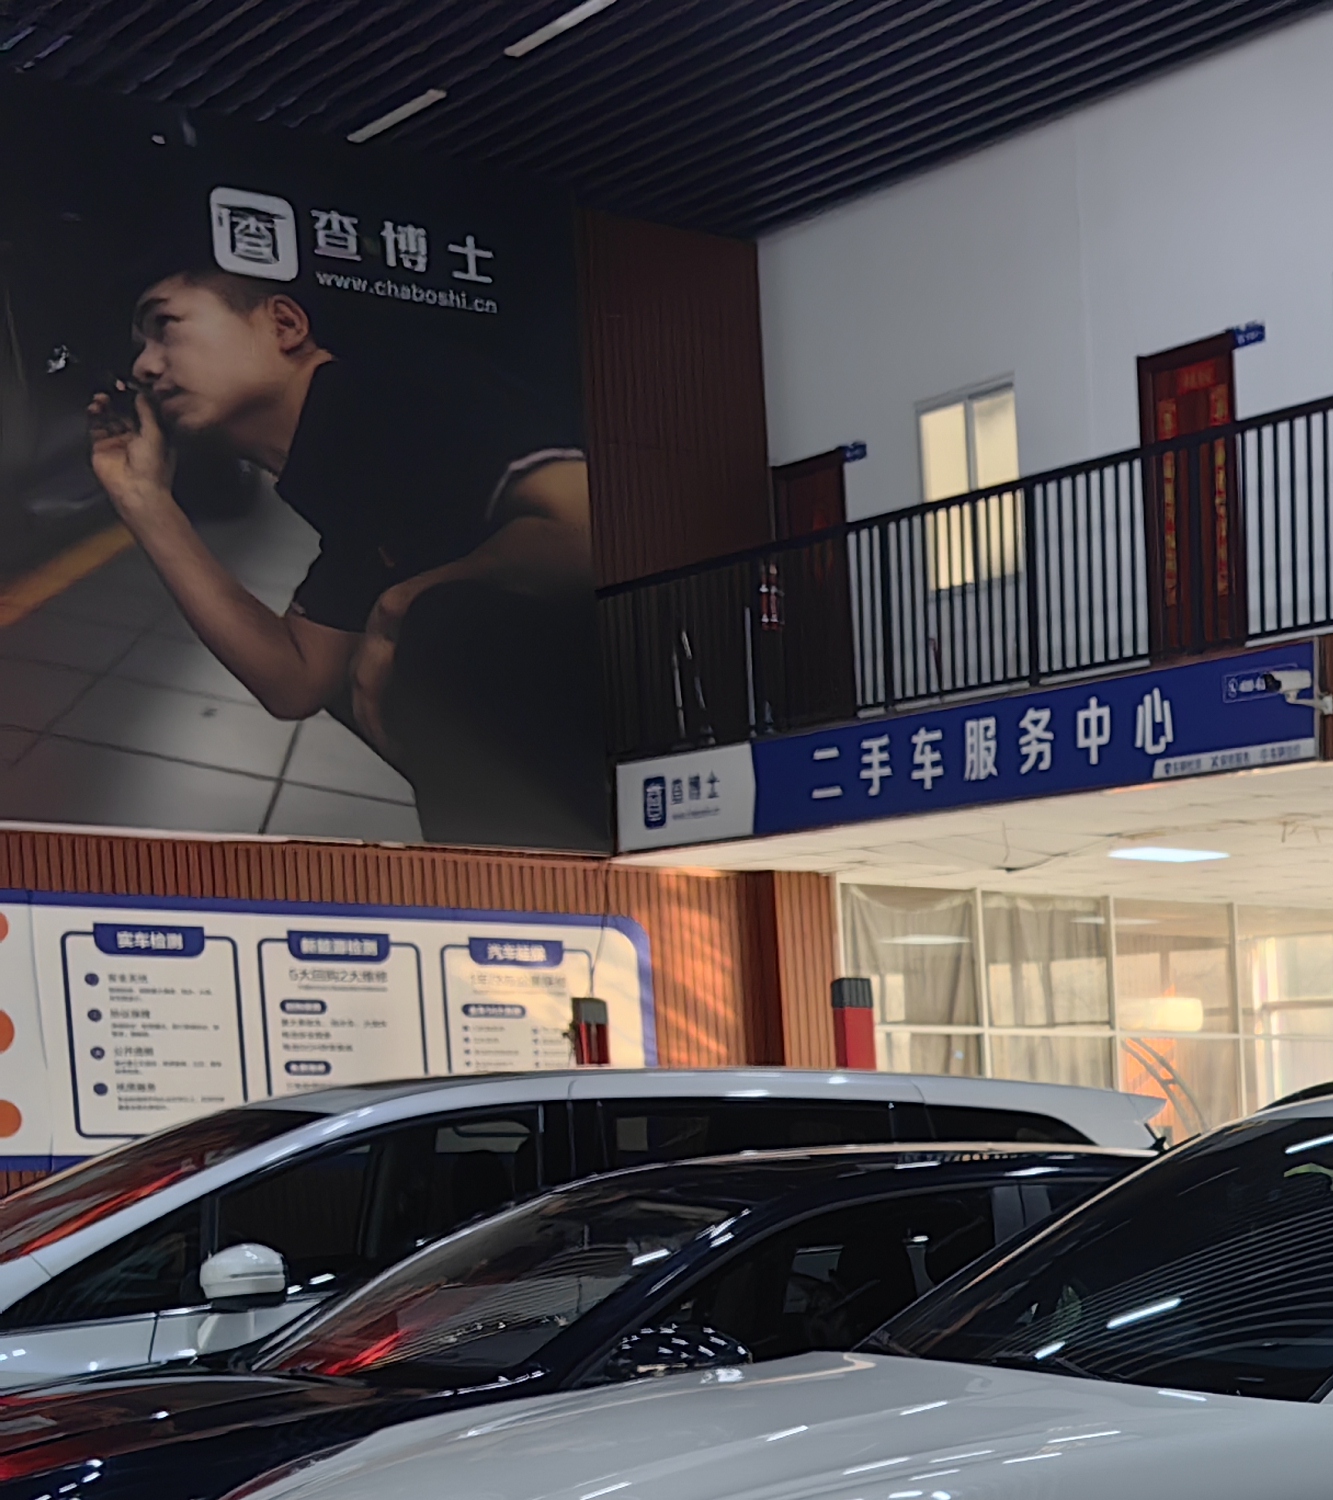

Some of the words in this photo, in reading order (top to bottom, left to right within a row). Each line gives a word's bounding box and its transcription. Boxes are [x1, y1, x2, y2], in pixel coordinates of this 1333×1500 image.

[310, 209, 494, 284] 查博士
[315, 270, 499, 315] www.chaboshi.cn
[811, 687, 1176, 801] 二手车服务中心
